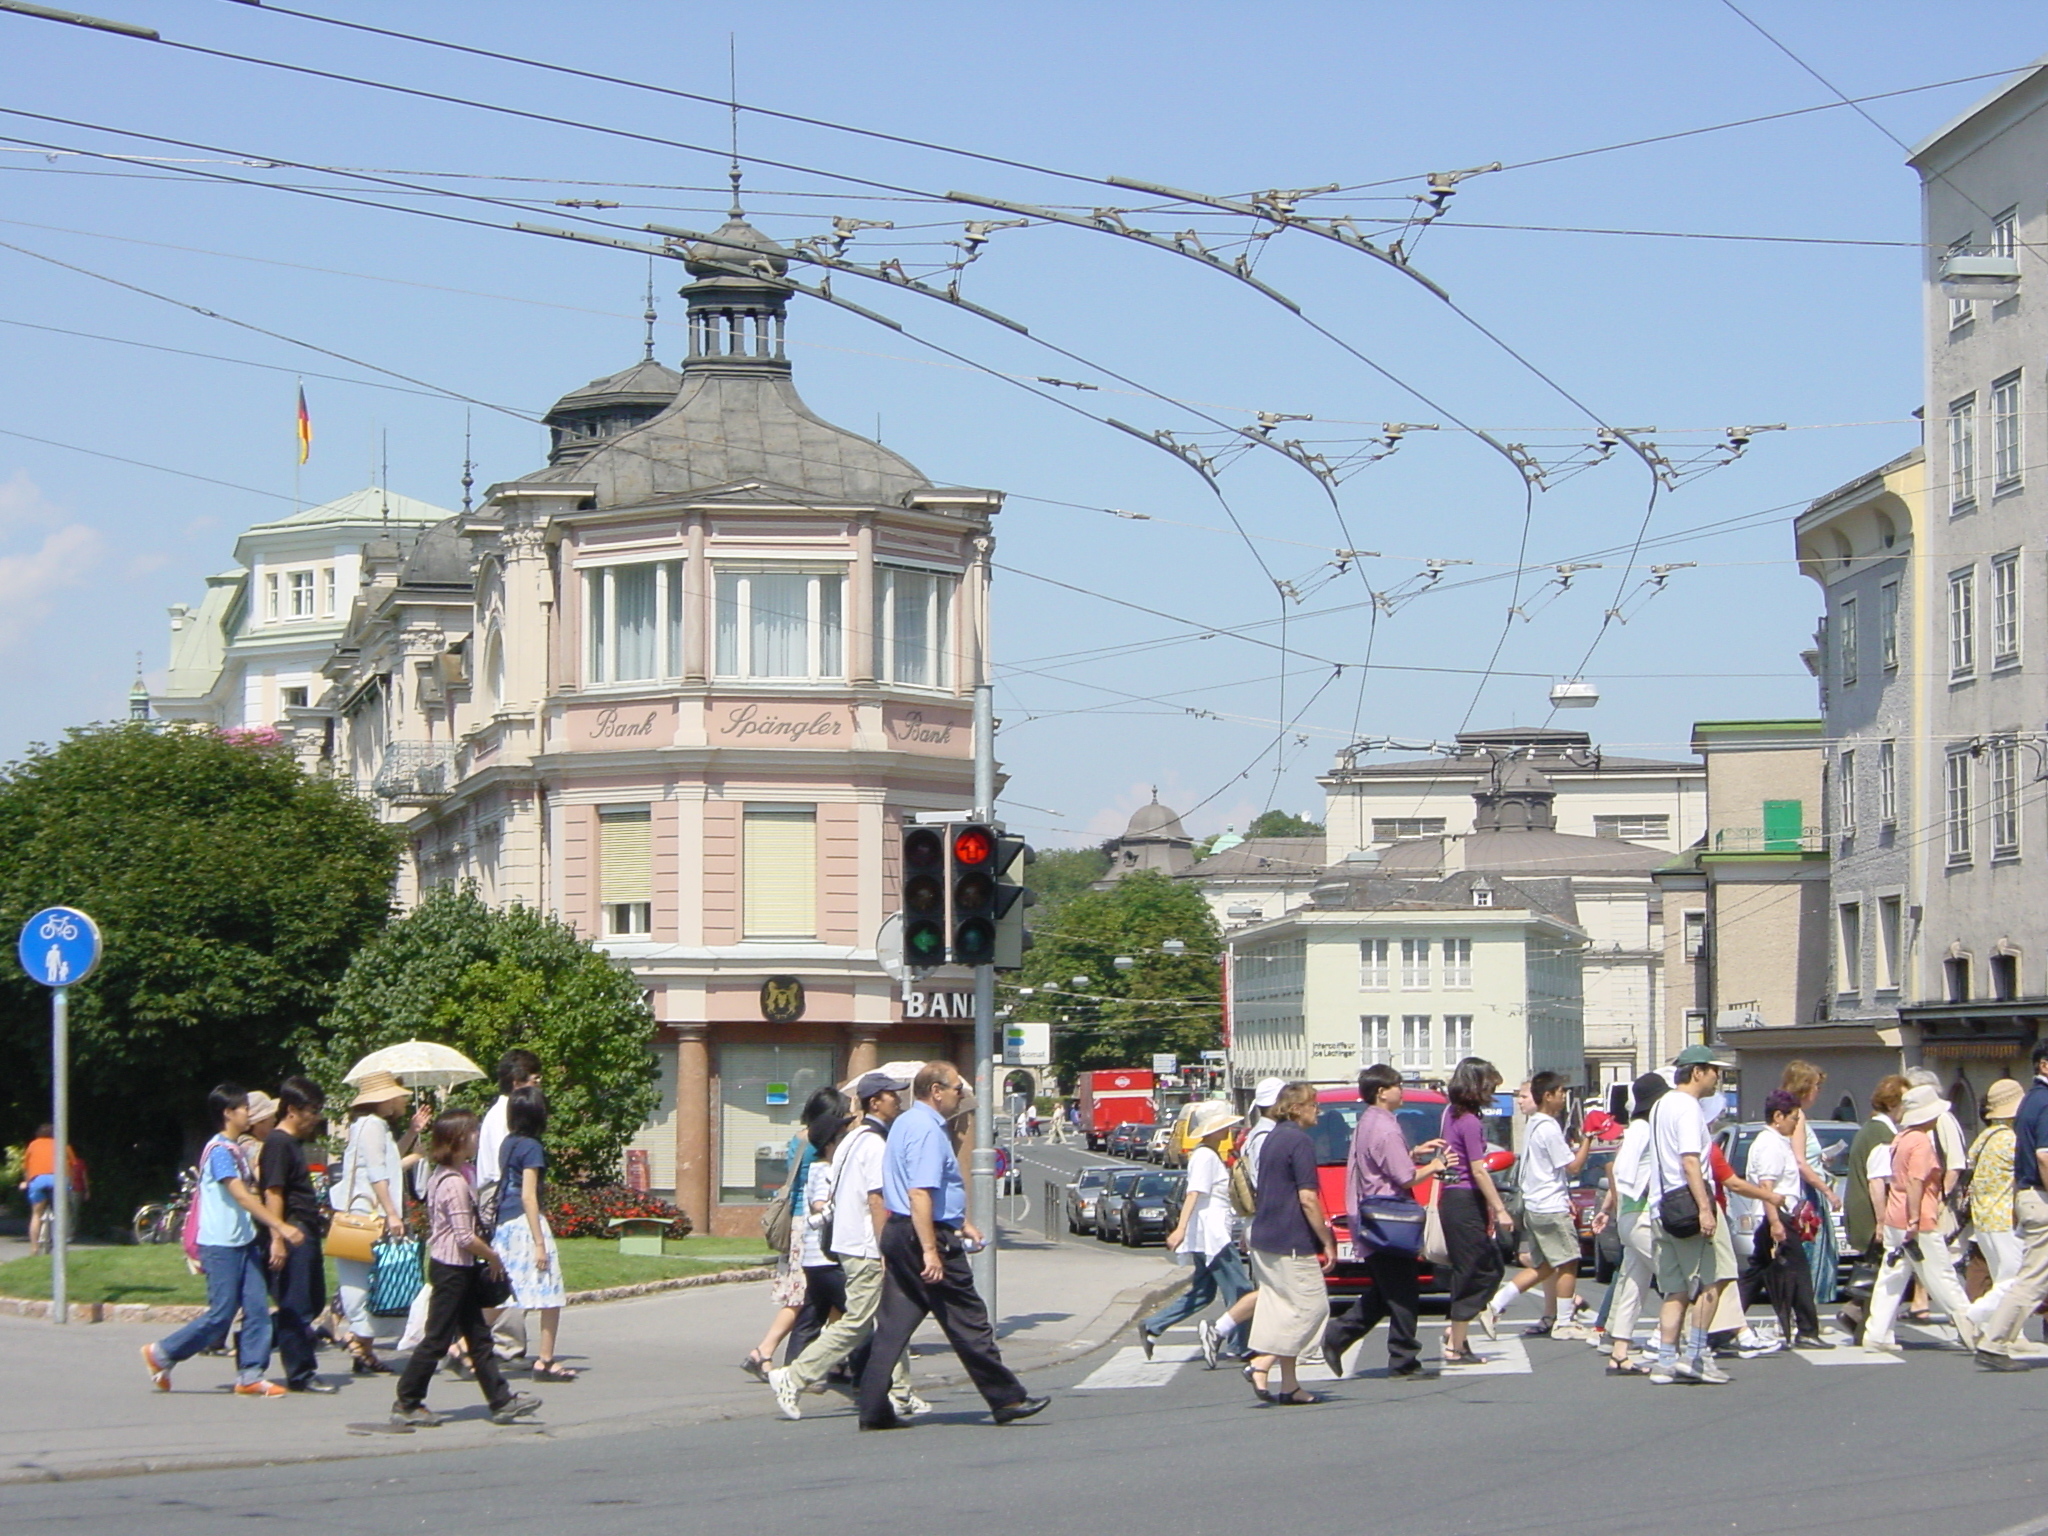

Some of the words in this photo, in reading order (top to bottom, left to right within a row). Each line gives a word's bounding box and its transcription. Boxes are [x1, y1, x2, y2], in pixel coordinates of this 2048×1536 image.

[589, 708, 657, 738] Bank
[720, 703, 842, 742] Spängler
[898, 711, 954, 743] Bank
